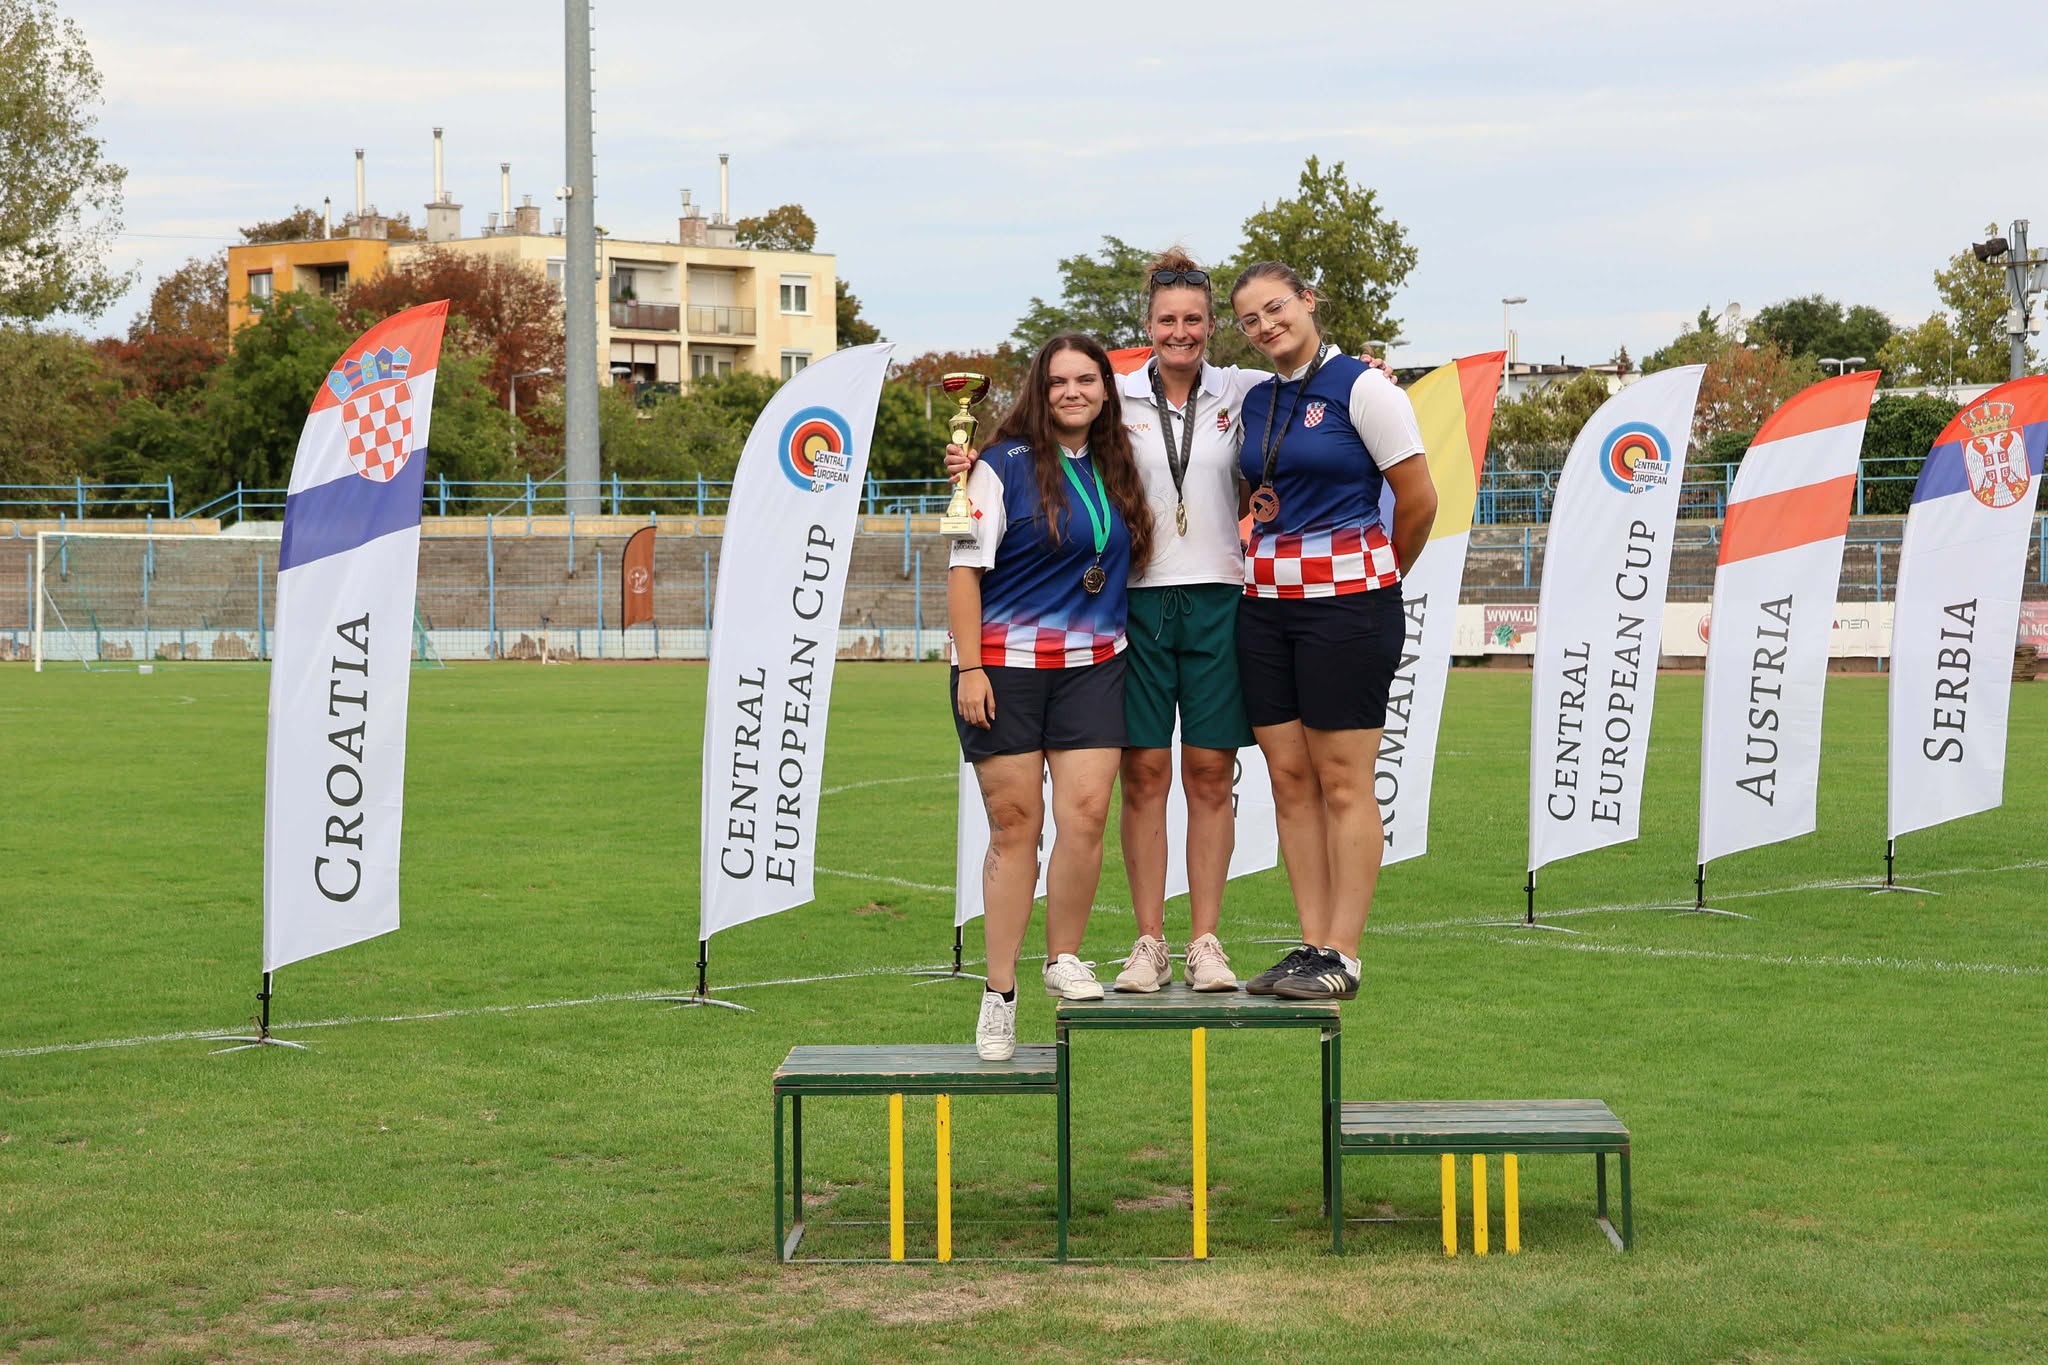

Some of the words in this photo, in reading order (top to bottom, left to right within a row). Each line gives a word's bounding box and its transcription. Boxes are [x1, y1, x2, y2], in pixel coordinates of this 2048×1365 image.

[810, 480, 825, 493] CUP
[813, 465, 849, 483] EUROPEAN
[815, 450, 844, 467] CENTRAL
[1629, 483, 1644, 495] CUP
[1631, 471, 1667, 485] EUROPEAN
[1634, 458, 1663, 472] CENTRAL
[792, 523, 836, 620] CUP
[1616, 520, 1656, 602] CUP
[1592, 612, 1645, 826] EUROPEAN
[1736, 594, 1793, 807] AUSTRIA
[1923, 598, 1978, 763] SERBIA
[315, 612, 370, 903] CROATIA
[721, 667, 766, 880] CENTRAL
[766, 633, 819, 887] EUROPEAN
[1548, 641, 1591, 821] CENTRAL
